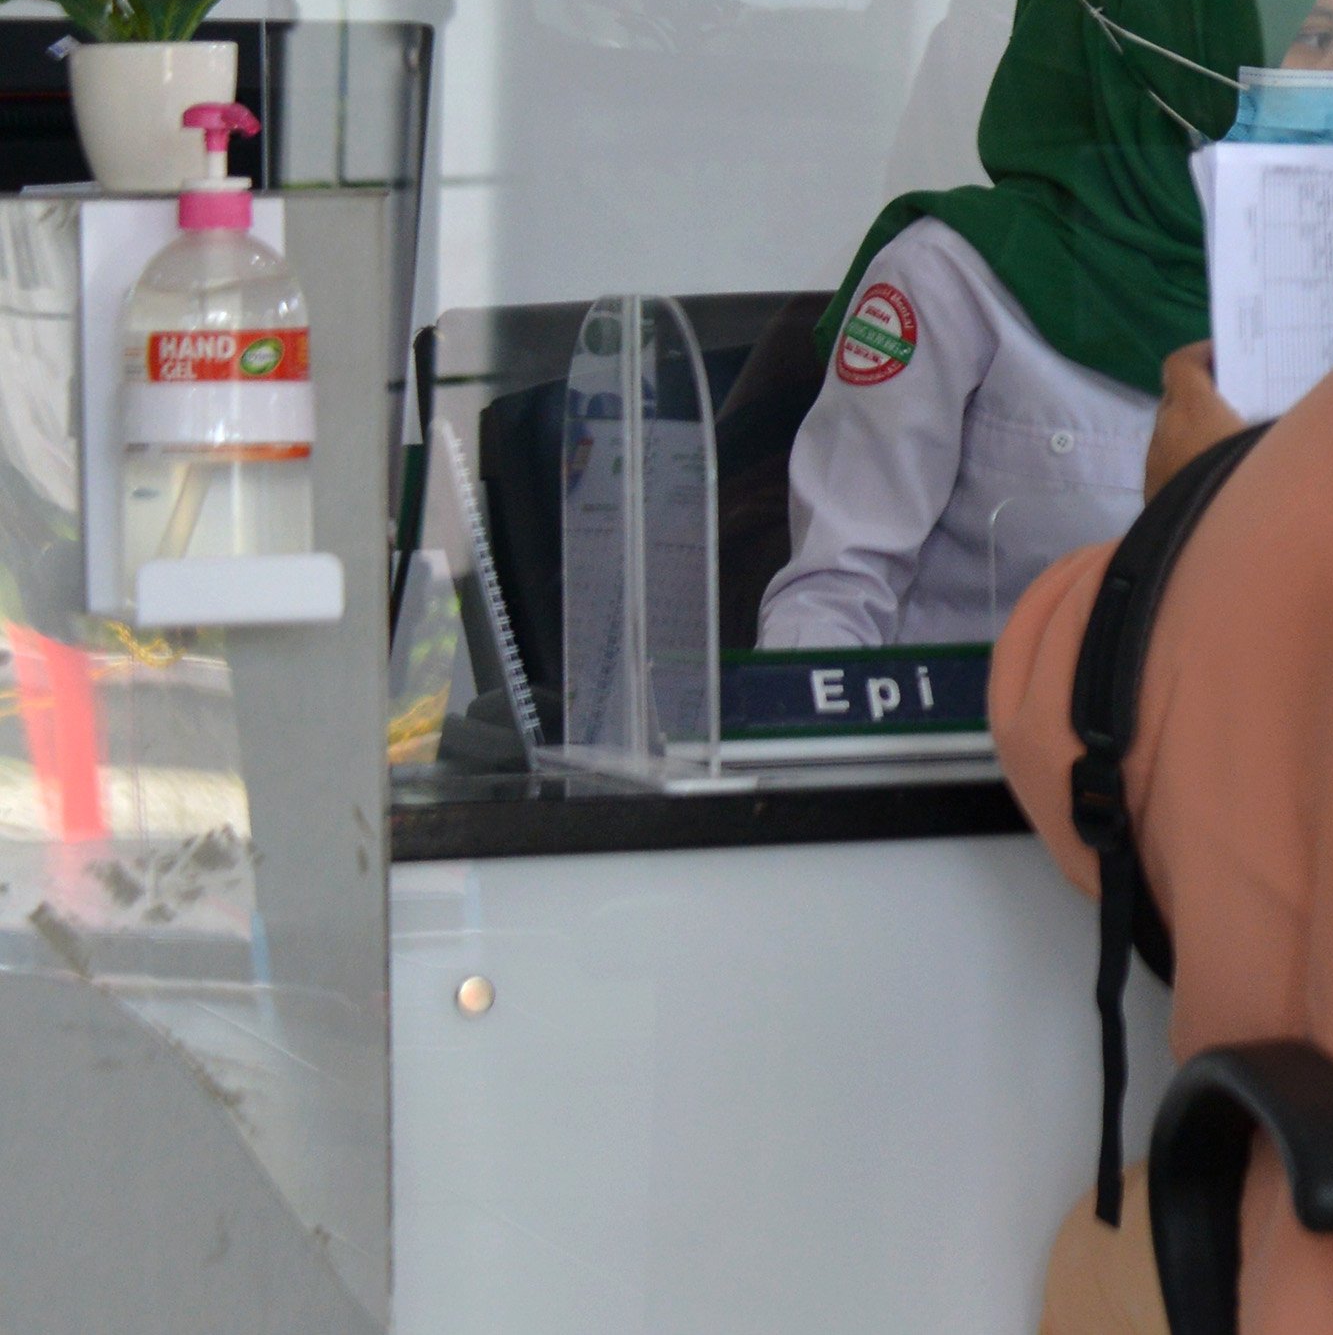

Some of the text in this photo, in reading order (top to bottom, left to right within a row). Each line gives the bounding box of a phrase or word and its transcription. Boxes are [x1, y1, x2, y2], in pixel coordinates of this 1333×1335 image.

[158, 334, 238, 362] HAND
[158, 360, 198, 380] GEL
[810, 665, 934, 722] Epi
